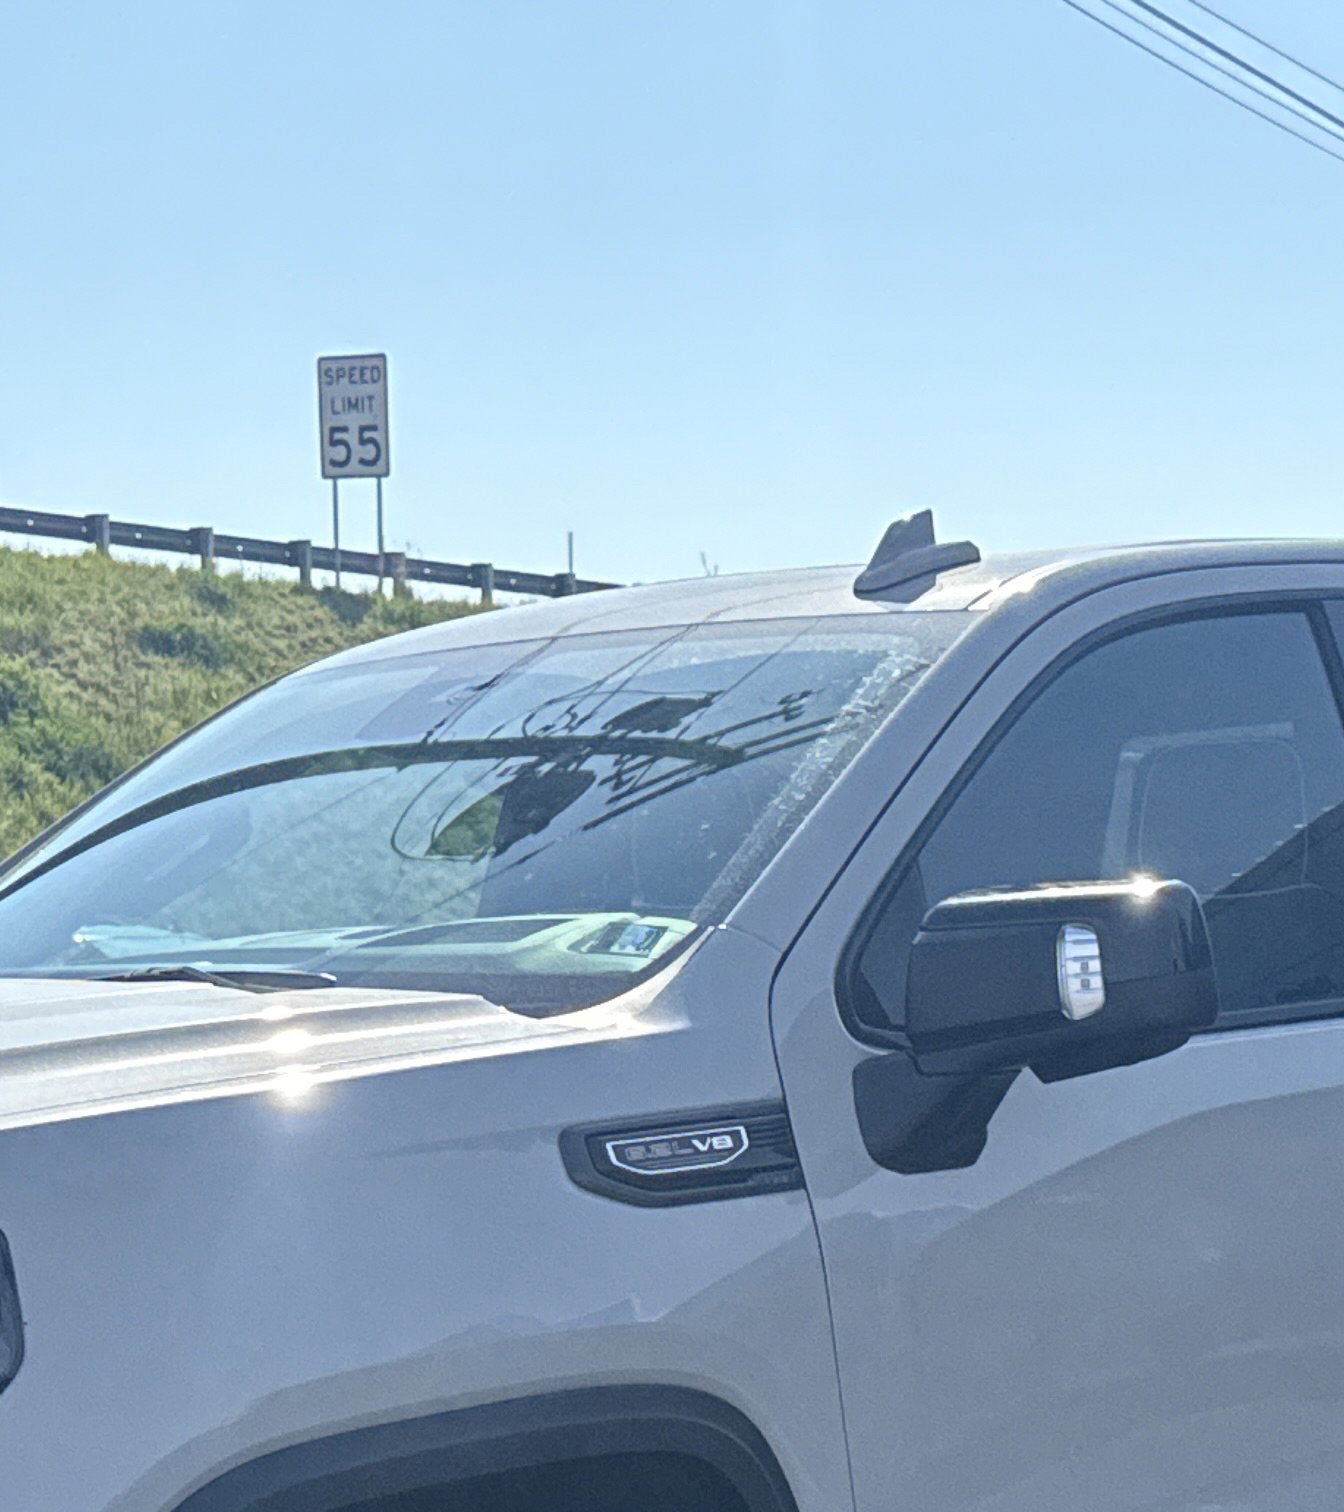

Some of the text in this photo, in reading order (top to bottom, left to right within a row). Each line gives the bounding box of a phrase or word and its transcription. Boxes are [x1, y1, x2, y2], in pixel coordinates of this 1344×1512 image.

[323, 366, 381, 386] SPEED
[330, 395, 375, 415] LIMIT
[328, 425, 382, 468] 55
[691, 1135, 734, 1151] V8
